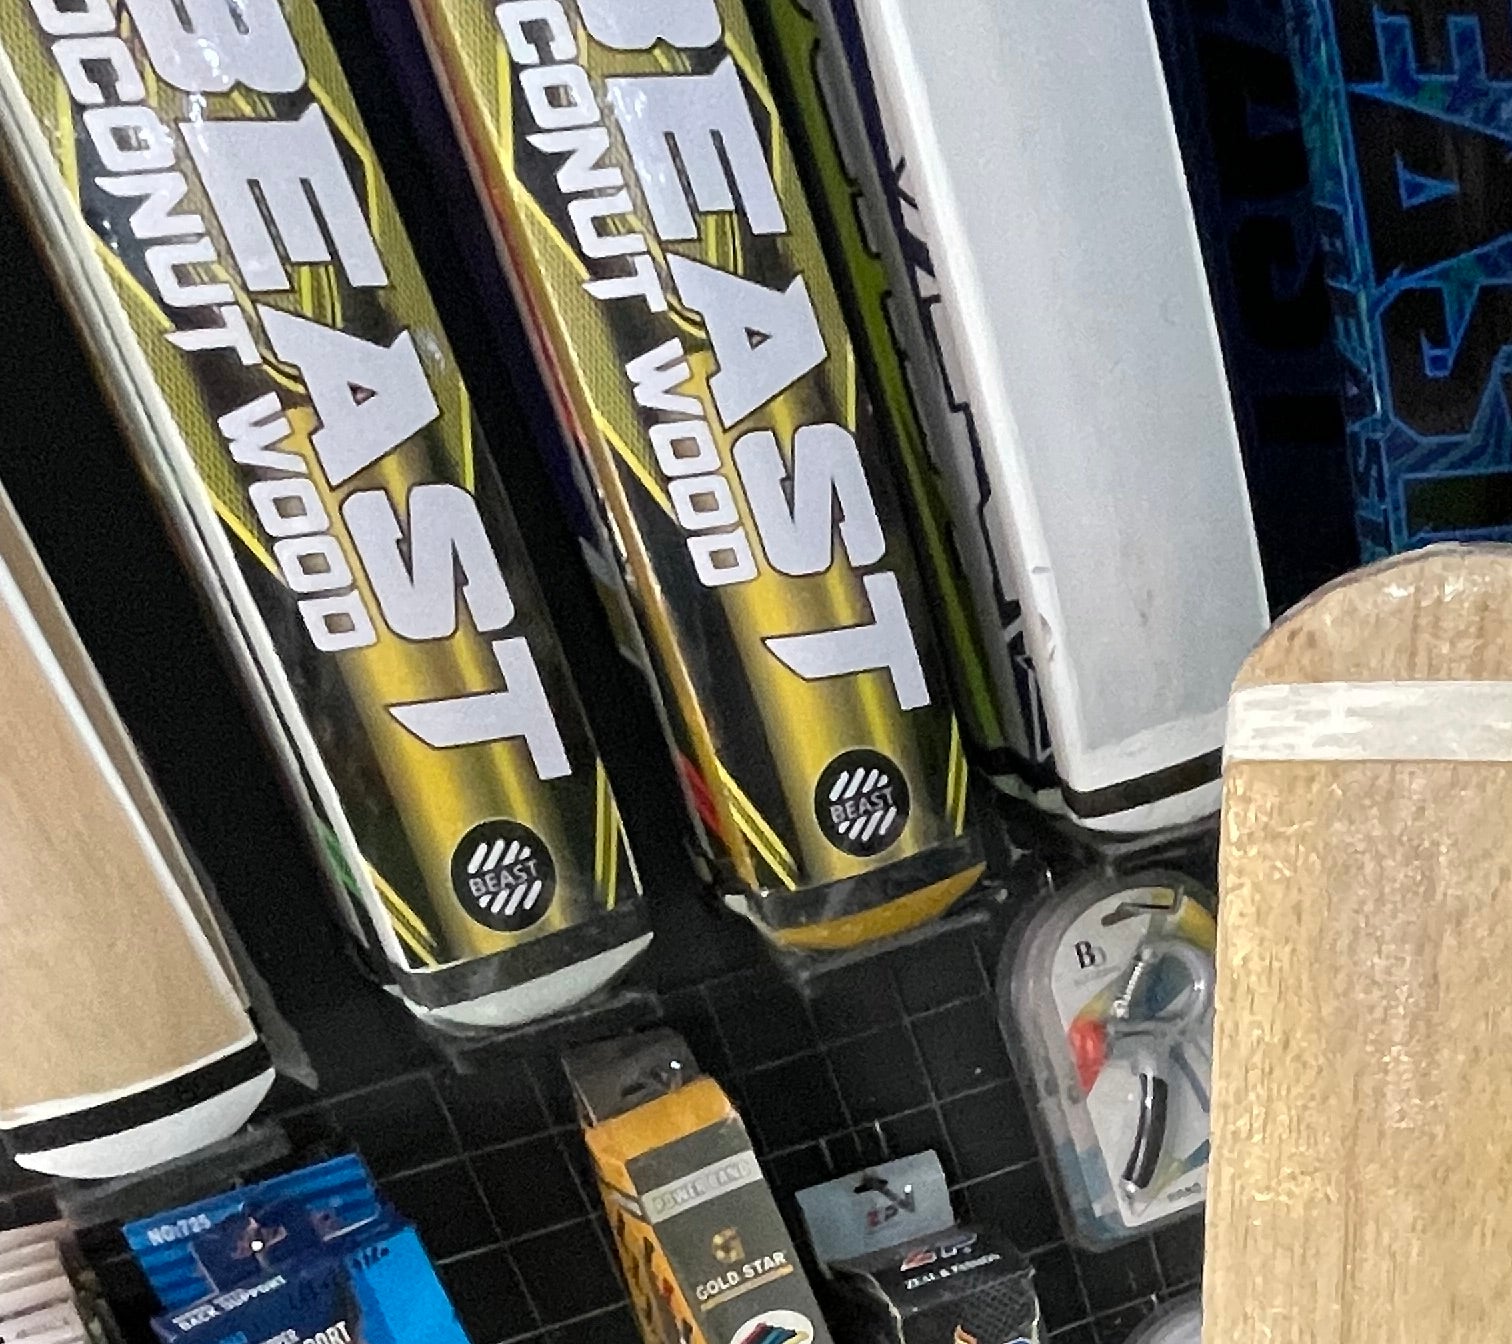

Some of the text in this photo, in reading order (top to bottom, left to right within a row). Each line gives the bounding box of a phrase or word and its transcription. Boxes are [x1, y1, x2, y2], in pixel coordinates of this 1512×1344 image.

[126, 0, 572, 781] BEAST
[625, 336, 758, 588] WOOD
[217, 391, 378, 652] WOOD
[468, 858, 540, 899] BEAST
[829, 785, 897, 824] BEAST
[696, 1251, 787, 1301] GOLD STAR
